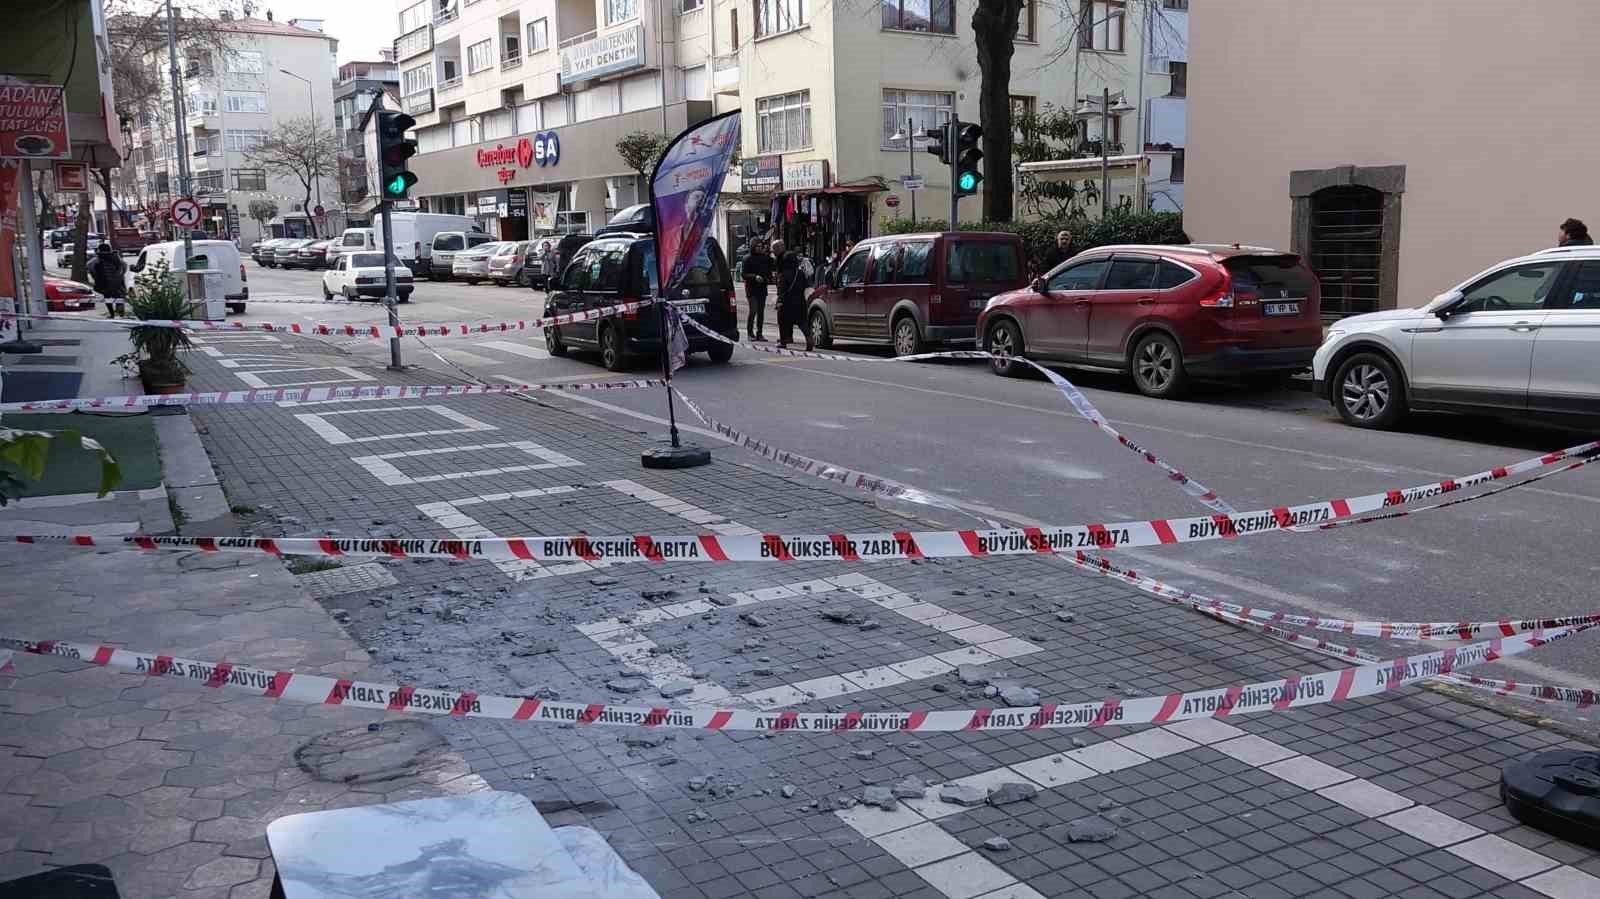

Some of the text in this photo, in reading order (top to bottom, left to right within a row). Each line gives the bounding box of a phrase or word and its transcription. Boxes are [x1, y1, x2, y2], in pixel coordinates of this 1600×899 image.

[536, 139, 556, 159] SA
[1281, 507, 1329, 529] ZABITA
[1077, 528, 1130, 547] ZABITA
[430, 540, 482, 555] ZABITA
[644, 541, 698, 557] ZABITA
[862, 539, 916, 555] ZABITA
